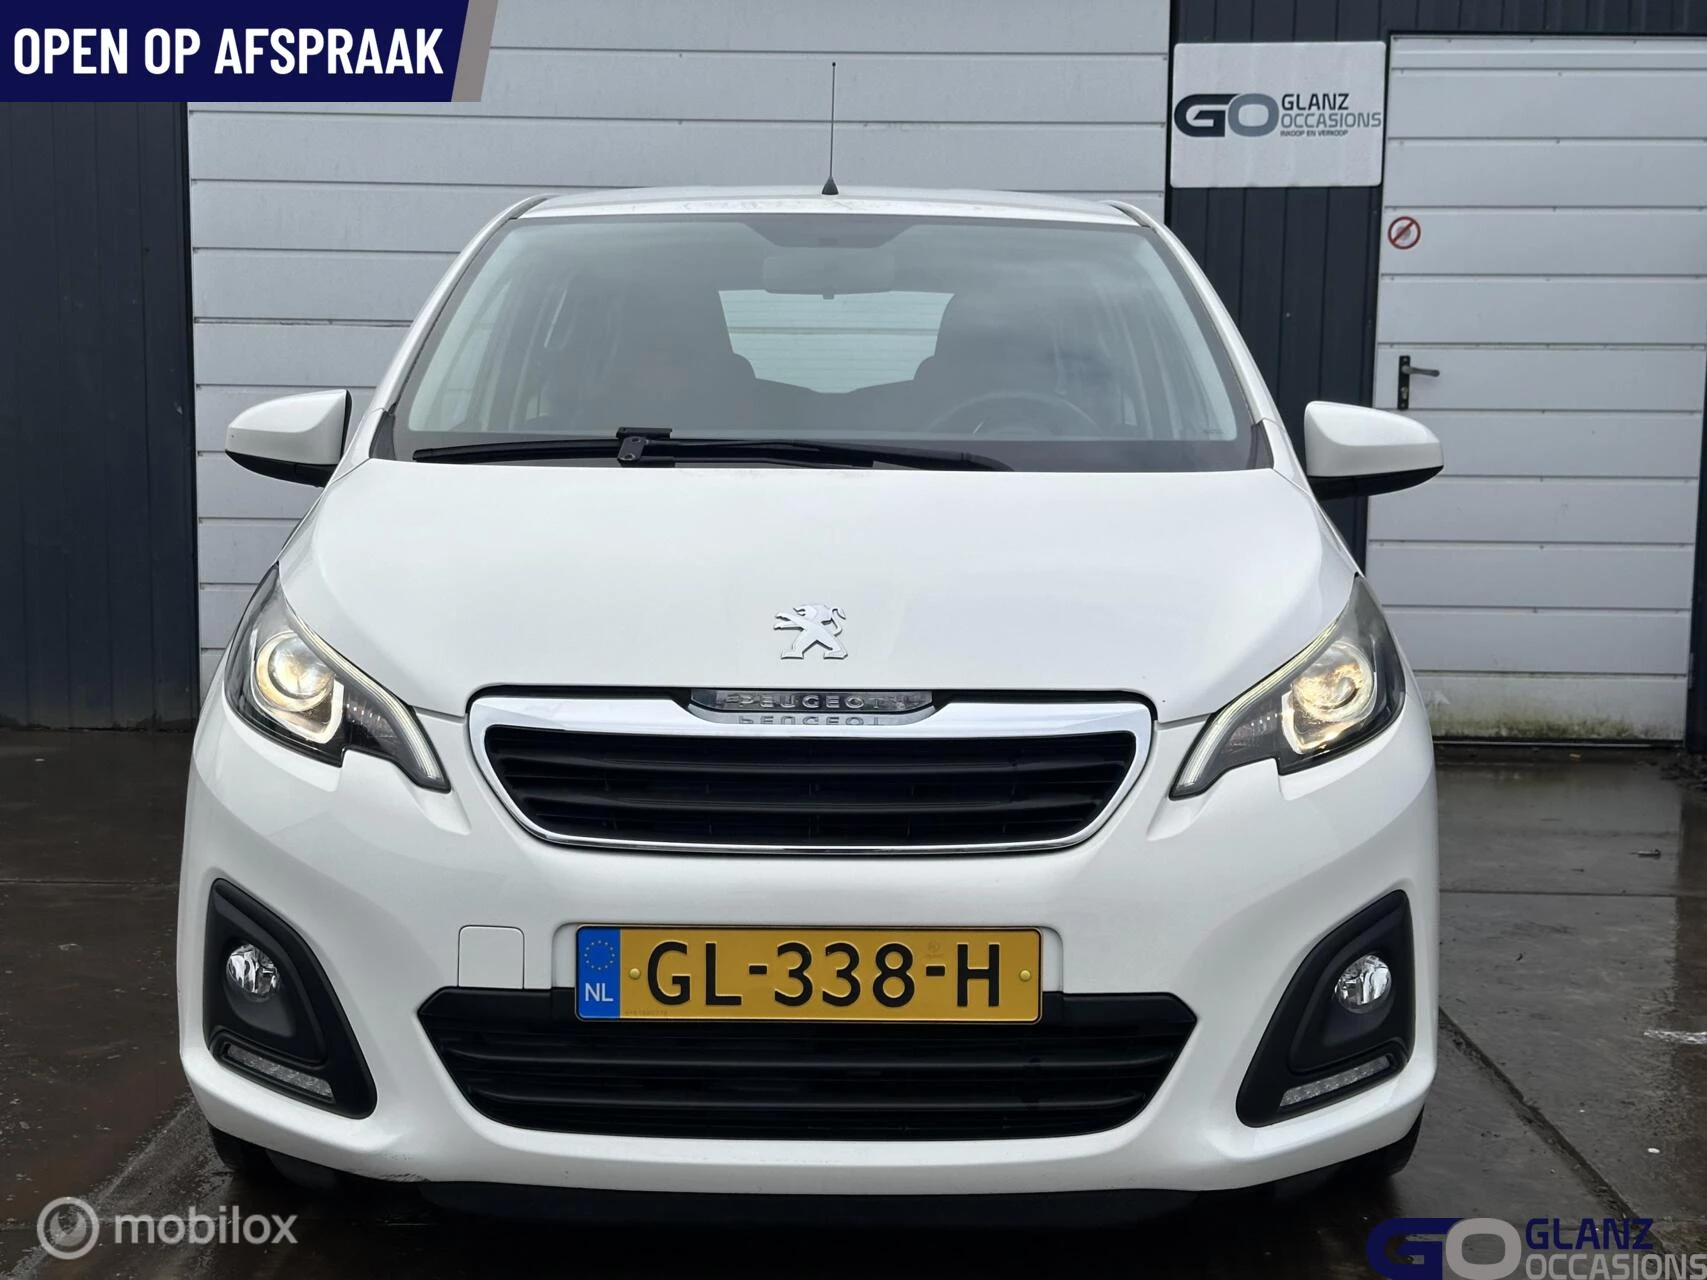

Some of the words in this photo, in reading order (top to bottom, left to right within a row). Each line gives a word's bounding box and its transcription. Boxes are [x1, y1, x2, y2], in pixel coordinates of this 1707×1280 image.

[1281, 93, 1350, 111] GLANZ
[1174, 93, 1280, 138] GO
[1281, 112, 1382, 129] OCCASIONS
[738, 694, 885, 709] PEUGEOT
[646, 940, 1001, 1008] GL-338-H
[584, 983, 614, 1003] NL
